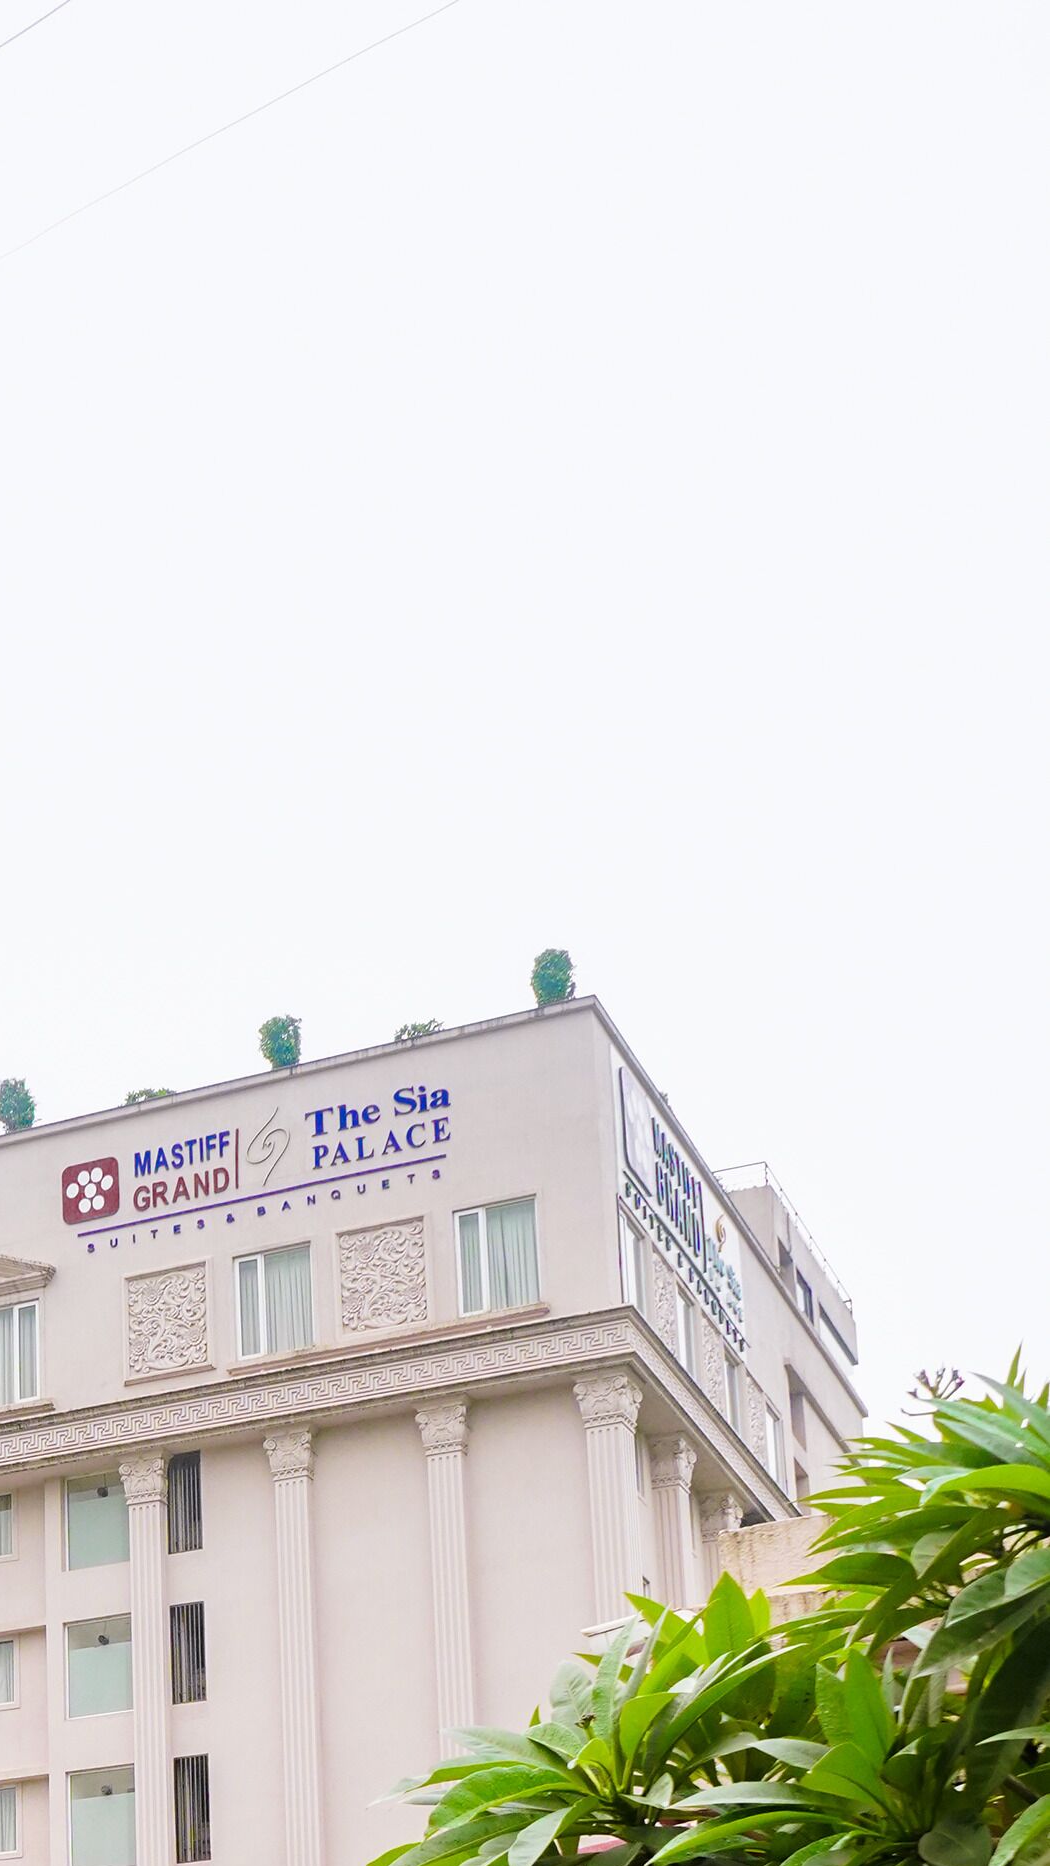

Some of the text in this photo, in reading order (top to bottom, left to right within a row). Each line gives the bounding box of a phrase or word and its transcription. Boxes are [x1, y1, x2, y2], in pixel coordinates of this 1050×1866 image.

[304, 1085, 451, 1138] The Sia
[134, 1130, 230, 1178] MASTIFF
[312, 1116, 451, 1170] PALACE
[87, 1169, 441, 1253] SUITES & BANQUETS
[133, 1167, 230, 1212] GRAND
